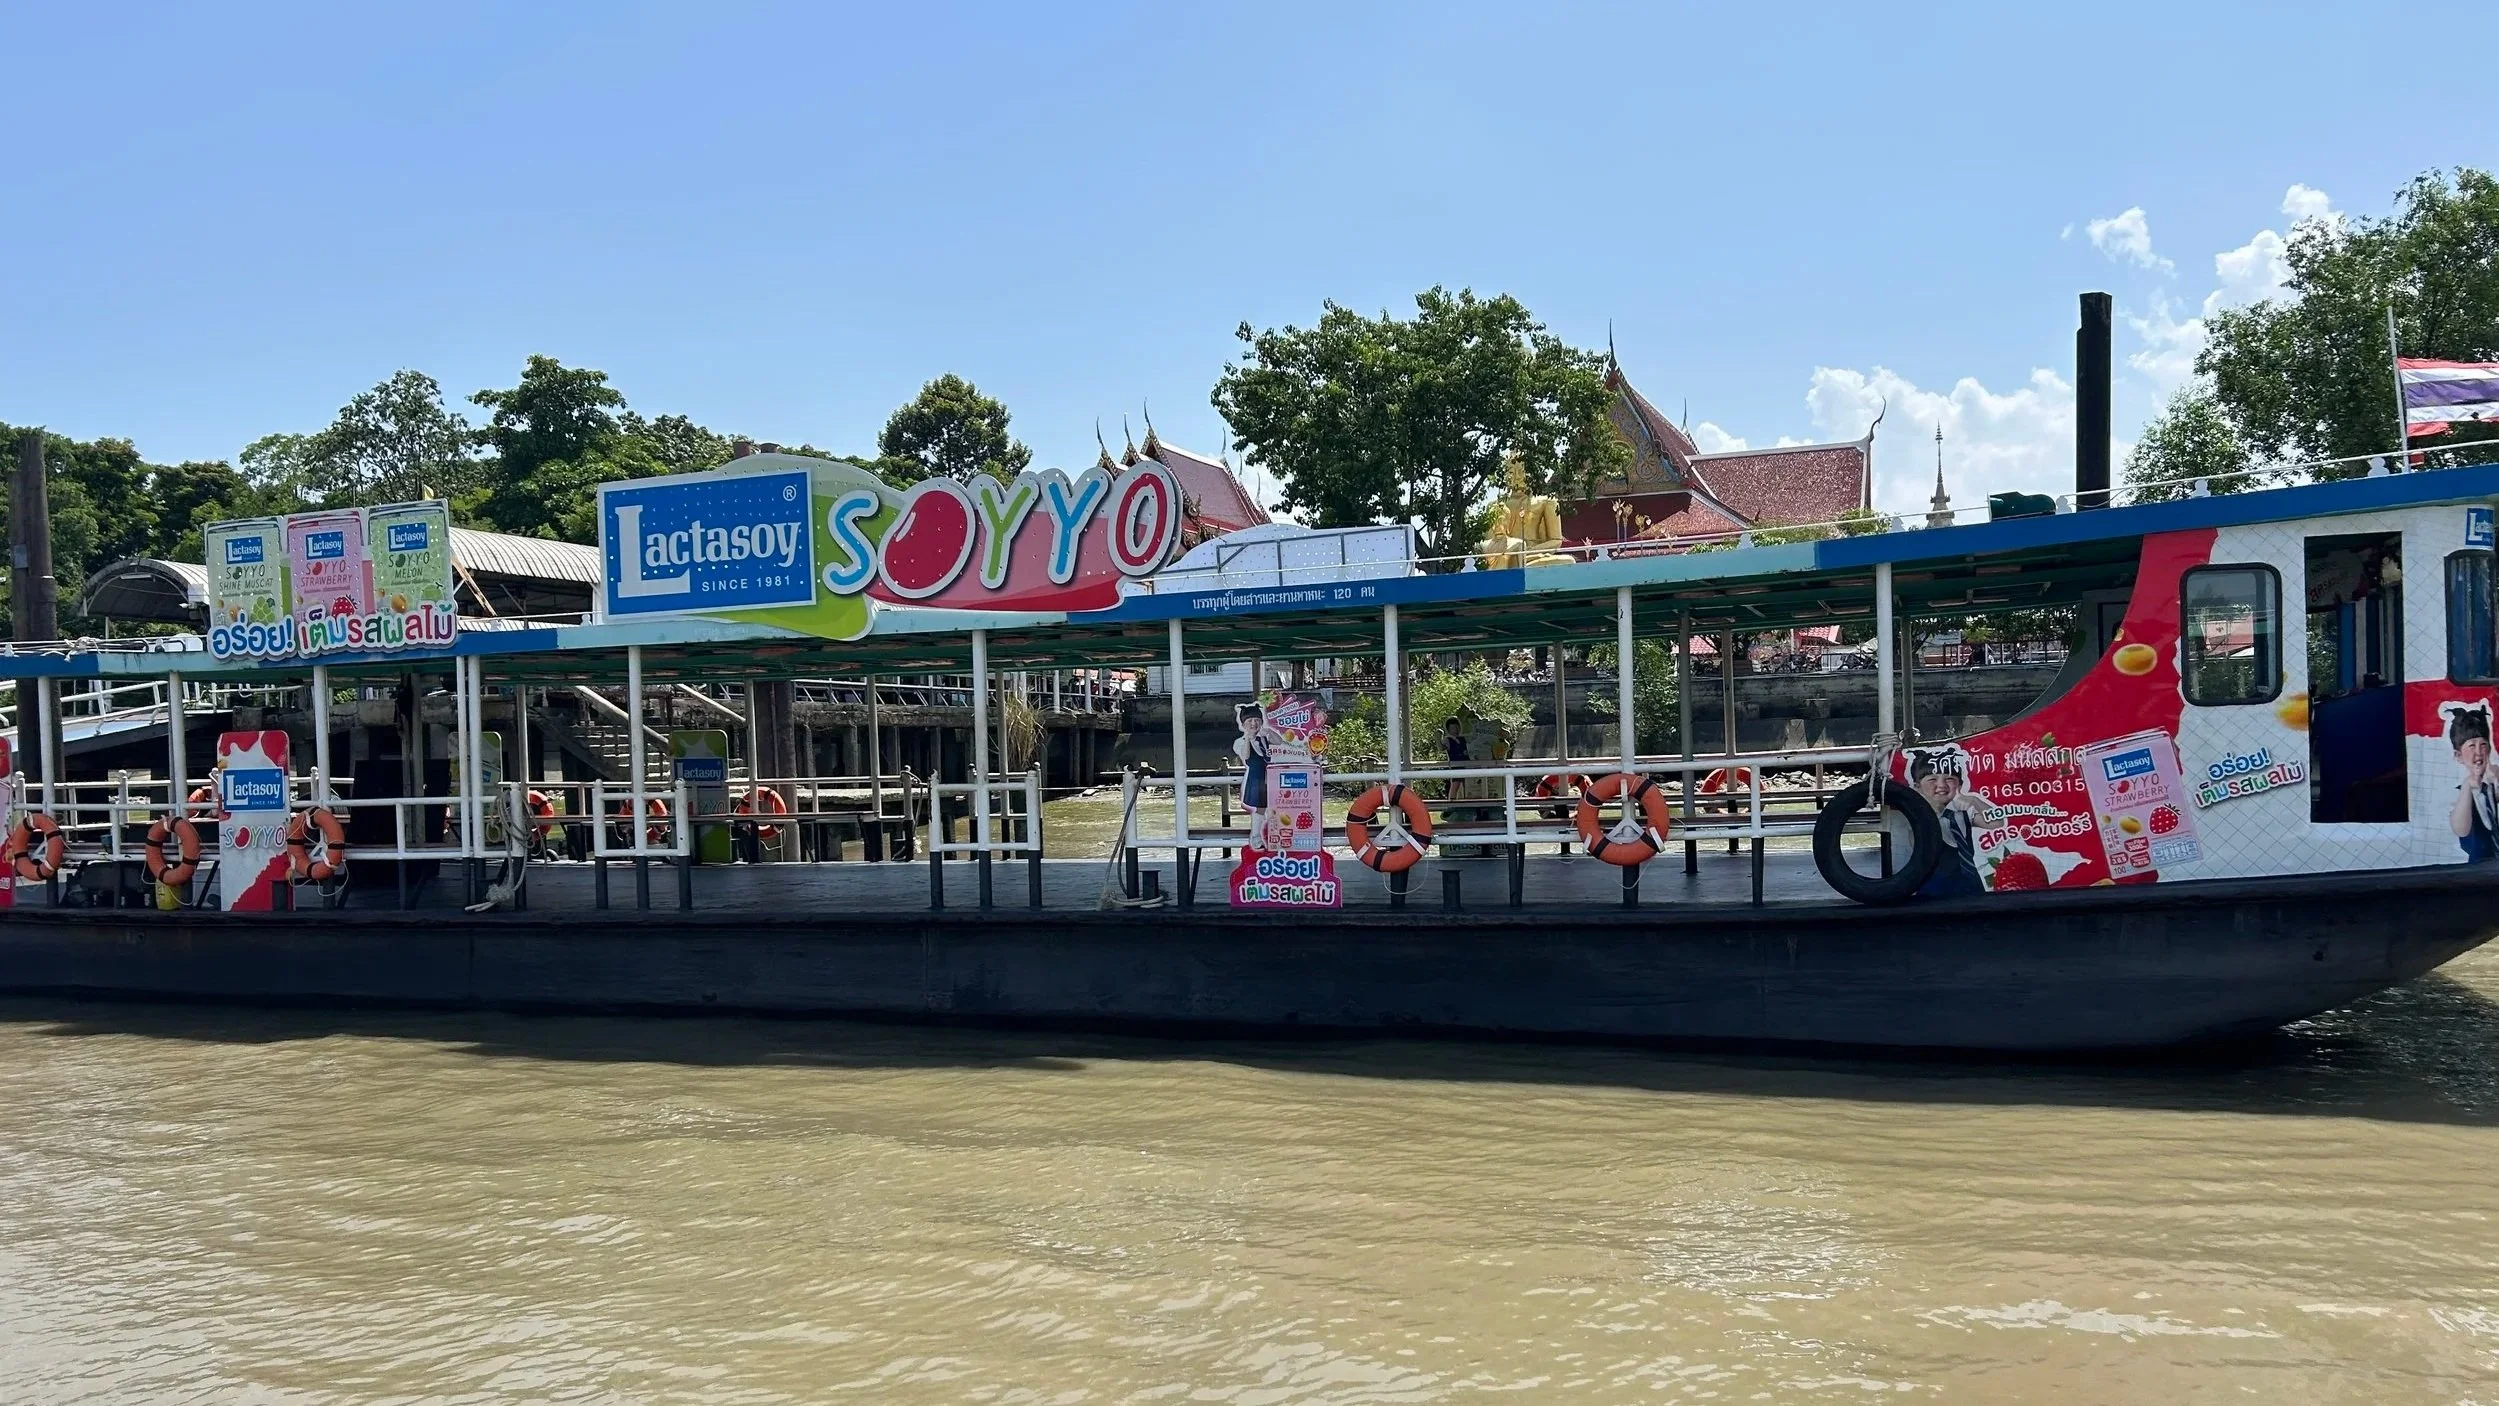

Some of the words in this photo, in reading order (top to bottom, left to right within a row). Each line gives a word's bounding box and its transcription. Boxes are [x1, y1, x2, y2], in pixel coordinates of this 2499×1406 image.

[390, 528, 425, 549] Lactasoy
[825, 468, 1174, 594] SOYYO
[227, 541, 261, 560] Lactasoy
[307, 537, 342, 557] Lactasoy
[615, 505, 801, 598] Lactasoy
[301, 574, 352, 587] STRAWBERRY
[395, 568, 422, 578] MELON
[702, 578, 748, 592] SINCE
[757, 575, 790, 588] 1981
[220, 581, 241, 592] SHINE
[245, 578, 273, 589] MUSCAT
[1334, 588, 1351, 599] 120
[1361, 586, 1375, 598] คน
[212, 612, 293, 655] อร่อย!
[301, 604, 453, 649] เต็มรสผลไม้
[2106, 756, 2150, 779] Lactasoy
[2209, 747, 2270, 778] อร่อย!
[226, 775, 280, 805] Lactasoy
[1979, 784, 2023, 799] 6165
[2029, 778, 2085, 795] 00315
[2196, 760, 2301, 805] เต็มรสผลไม้
[2105, 784, 2169, 807] STRAWBERRY
[1258, 851, 1318, 878] อร่อย!
[1242, 879, 1332, 902] เต็มรสผลไม้
